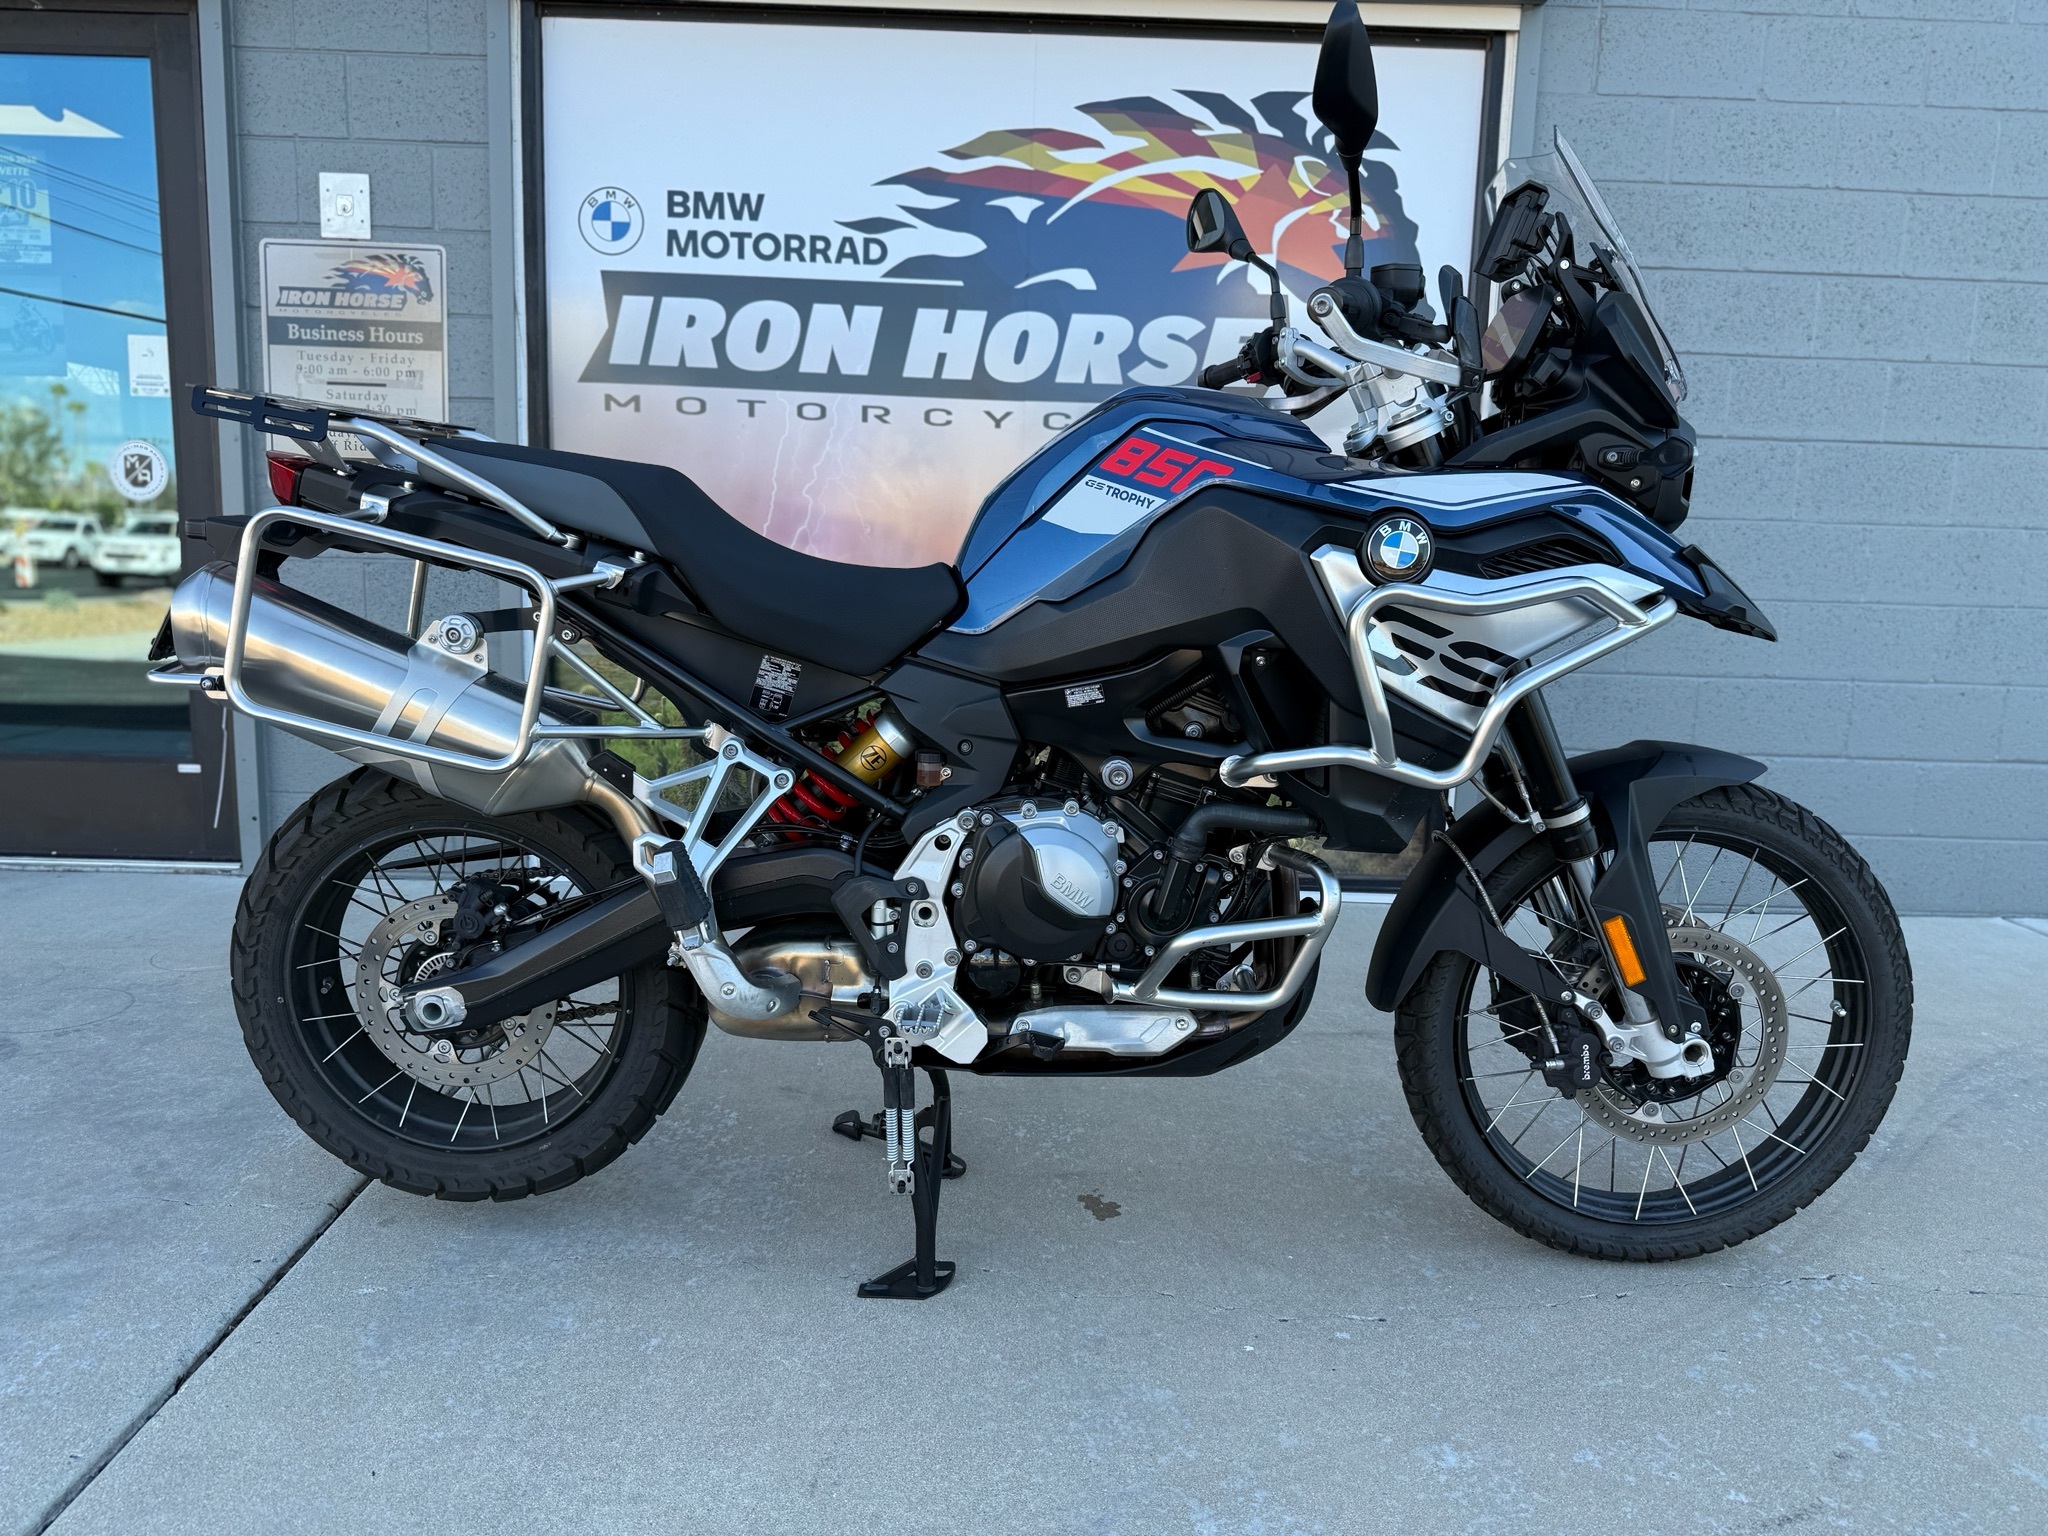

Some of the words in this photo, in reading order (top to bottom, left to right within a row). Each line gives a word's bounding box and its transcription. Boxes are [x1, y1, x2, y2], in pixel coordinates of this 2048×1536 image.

[587, 190, 635, 209] BMW
[666, 189, 765, 222] BMW
[666, 229, 888, 266] MOTORRAD
[279, 290, 330, 306] IRON
[334, 292, 404, 308] HORSE
[279, 308, 402, 317] MOTORCYCLES
[287, 323, 365, 342] Business
[369, 326, 424, 344] Hours
[608, 294, 883, 376] IRON
[902, 308, 1270, 388] HORSE
[297, 350, 354, 365] Tuesday
[370, 353, 415, 367] Friday
[296, 364, 323, 375] 9:00
[328, 367, 347, 375] am
[363, 367, 390, 377] 6:00
[396, 370, 416, 380] pm
[326, 389, 388, 404] Saturday
[604, 393, 1070, 430] MOTORCYC
[1105, 484, 1156, 510] TROPHY
[1379, 520, 1428, 545] BMW
[1050, 872, 1095, 909] BMW
[1581, 1044, 1591, 1080] brembo
